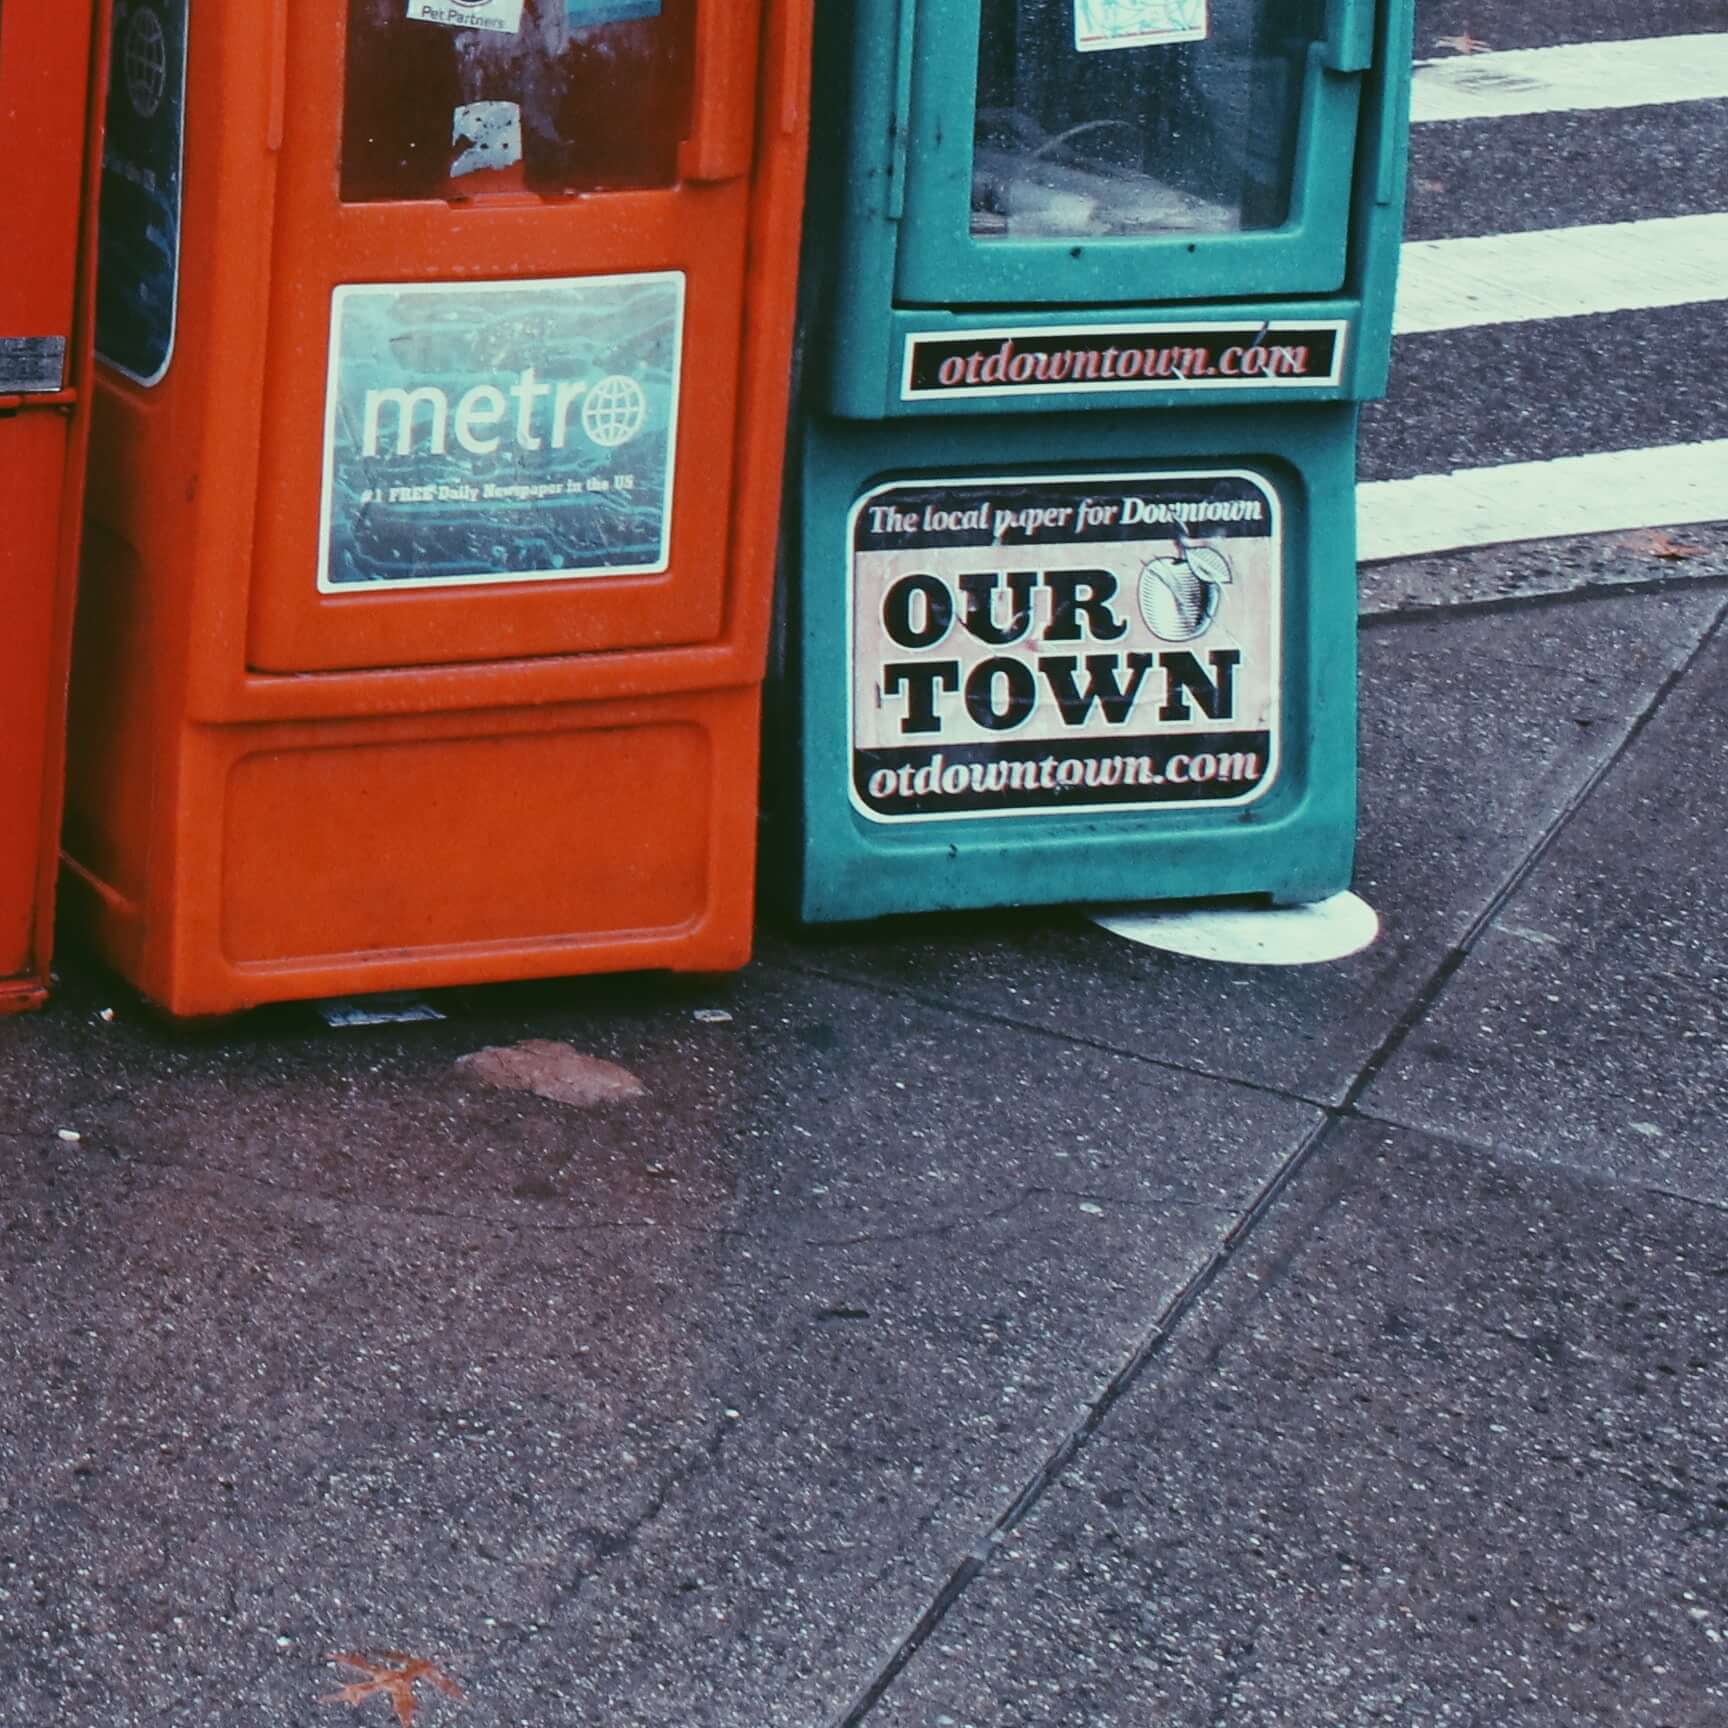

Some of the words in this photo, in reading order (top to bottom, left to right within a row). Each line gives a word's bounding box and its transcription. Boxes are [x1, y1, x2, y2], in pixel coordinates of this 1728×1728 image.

[421, 5, 446, 22] Pet
[447, 8, 505, 29] Partners
[937, 339, 1310, 386] otdowntown.com
[388, 484, 434, 502] FREE
[437, 484, 480, 502] Daily
[483, 481, 564, 500] Newspaper
[566, 478, 582, 492] in
[586, 476, 610, 491] the
[613, 474, 635, 490] US
[869, 504, 920, 535] The
[923, 500, 990, 533] local
[993, 502, 1073, 546] paper
[1075, 498, 1118, 535] for
[1121, 496, 1263, 527] Downtown
[881, 568, 1130, 650] OUR
[881, 648, 1242, 736] TOWN
[867, 748, 1261, 799] otdowntown.com
